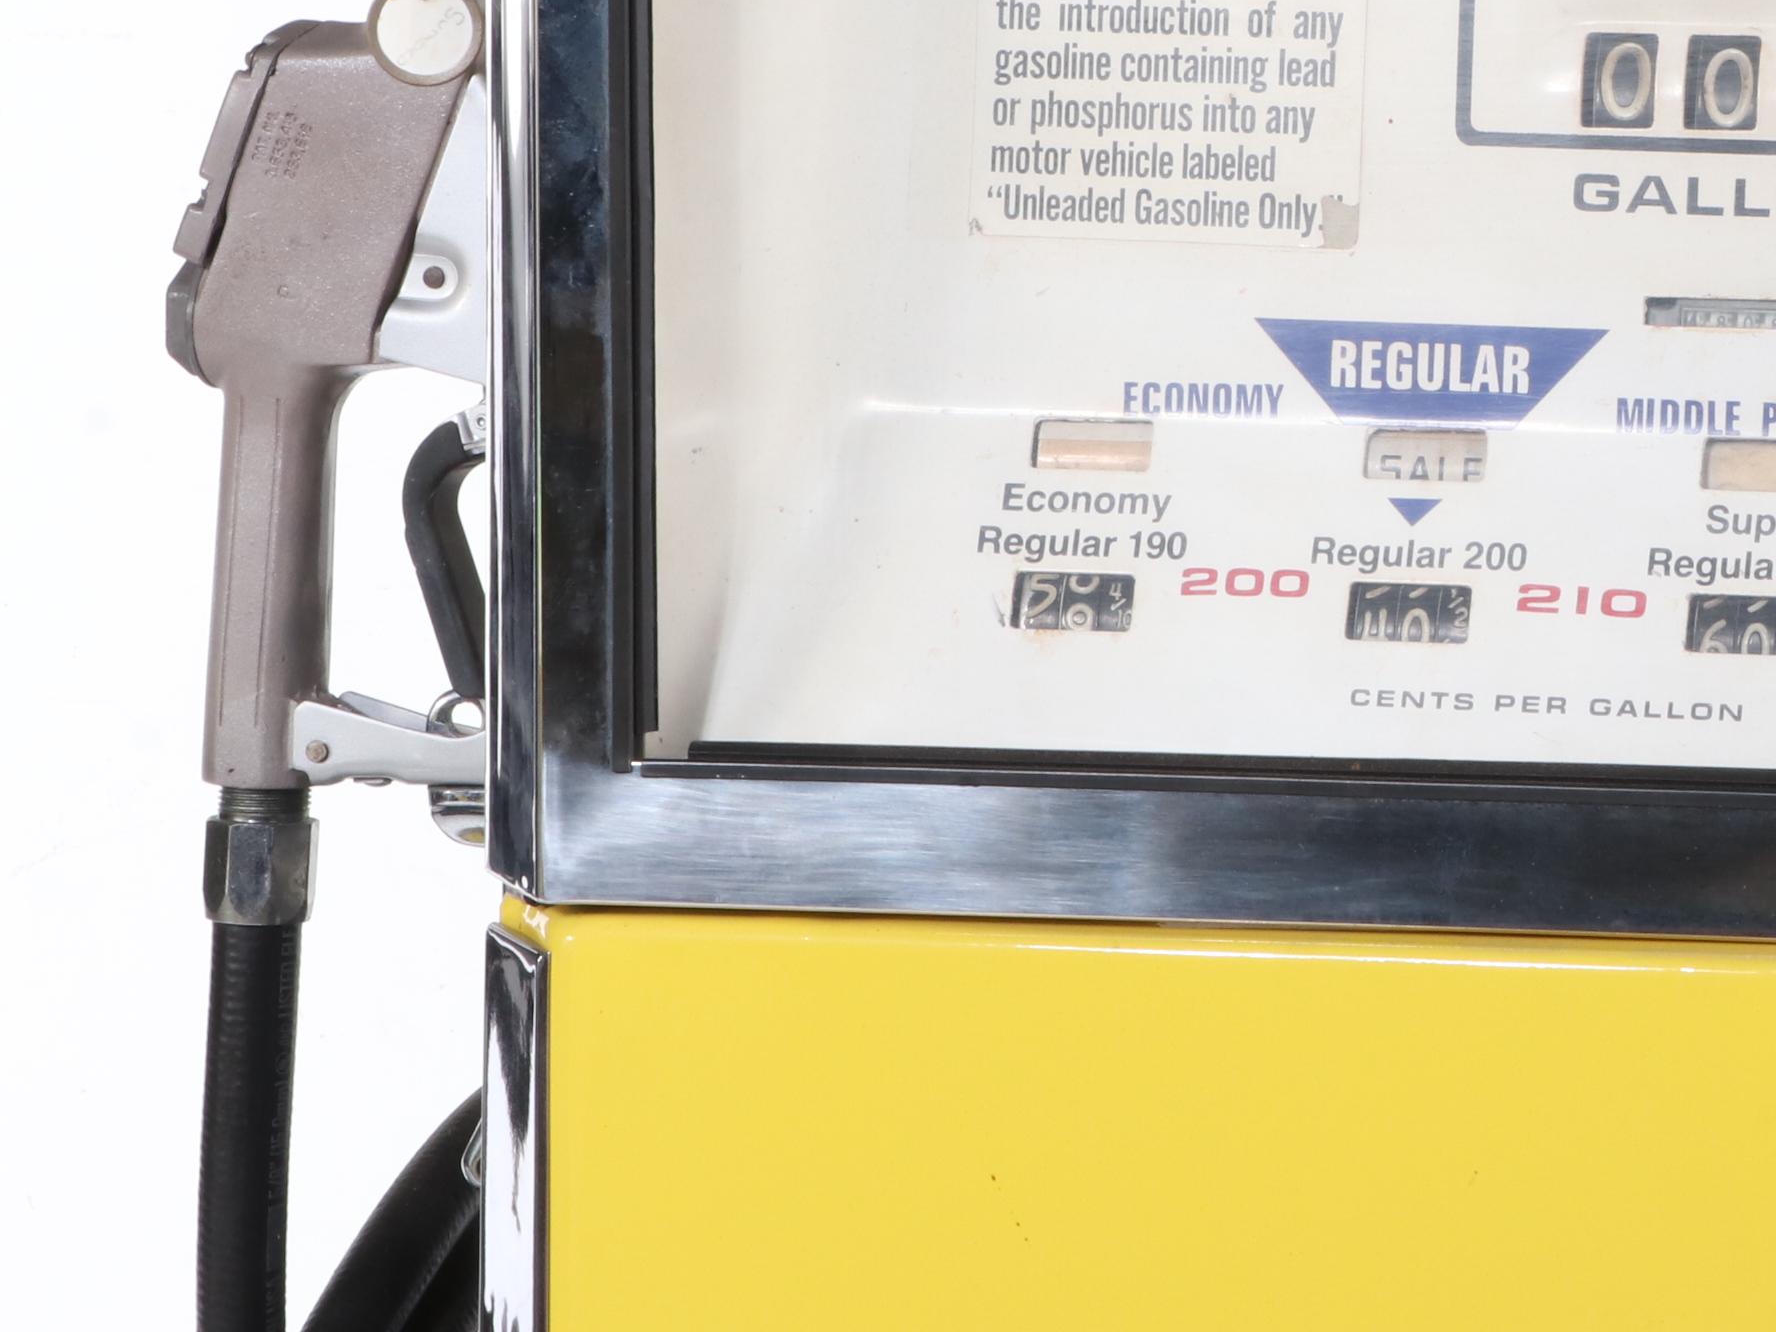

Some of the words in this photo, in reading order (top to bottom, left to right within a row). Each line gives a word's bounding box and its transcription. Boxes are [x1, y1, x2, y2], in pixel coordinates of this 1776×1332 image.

[1247, 0, 1277, 38] of
[1293, 9, 1344, 49] any
[994, 42, 1112, 85] gasoline
[1120, 47, 1268, 93] containing
[1278, 49, 1337, 87] lead
[992, 96, 1021, 127] or
[1030, 90, 1192, 137] phosphorus
[1202, 94, 1256, 134] into
[1265, 106, 1316, 143] any
[990, 140, 1071, 175] motor
[1080, 141, 1174, 179] vehicle
[1182, 143, 1276, 182] labeled
[1135, 188, 1250, 228] Gasoline
[1330, 339, 1530, 394] REGULAR
[1123, 381, 1284, 419] ECONOMY
[1616, 398, 1740, 436] MIDDLE
[1001, 482, 1172, 523] Economy
[977, 526, 1117, 564] Regular
[1130, 531, 1188, 561] 190
[1311, 536, 1452, 575] Regular
[1465, 541, 1528, 571] 200
[1180, 567, 1310, 599] 200
[1517, 583, 1647, 618] 210
[1350, 688, 1475, 712] CENTS
[1494, 693, 1567, 715] PER
[1589, 698, 1743, 722] GALLON
